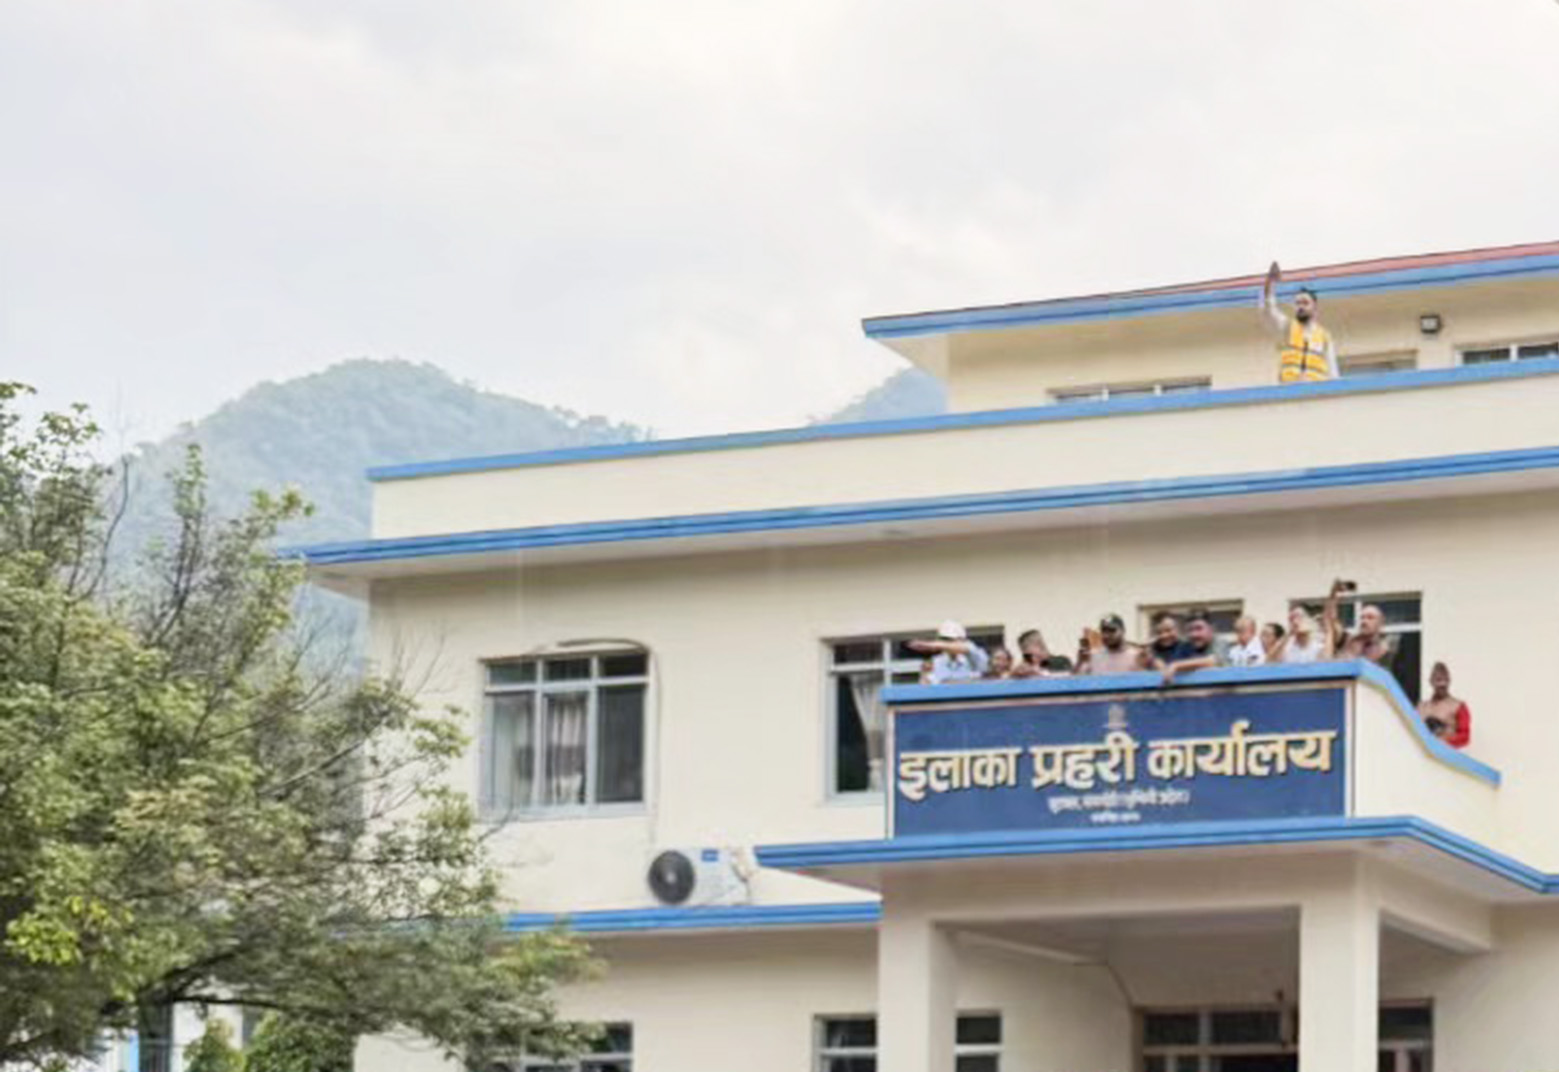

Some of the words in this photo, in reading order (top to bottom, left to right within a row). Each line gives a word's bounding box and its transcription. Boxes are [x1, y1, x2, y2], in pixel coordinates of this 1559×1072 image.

[898, 747, 1022, 800] इलाका
[1031, 732, 1139, 790] प्रहरी
[1148, 719, 1338, 778] कार्यालय
